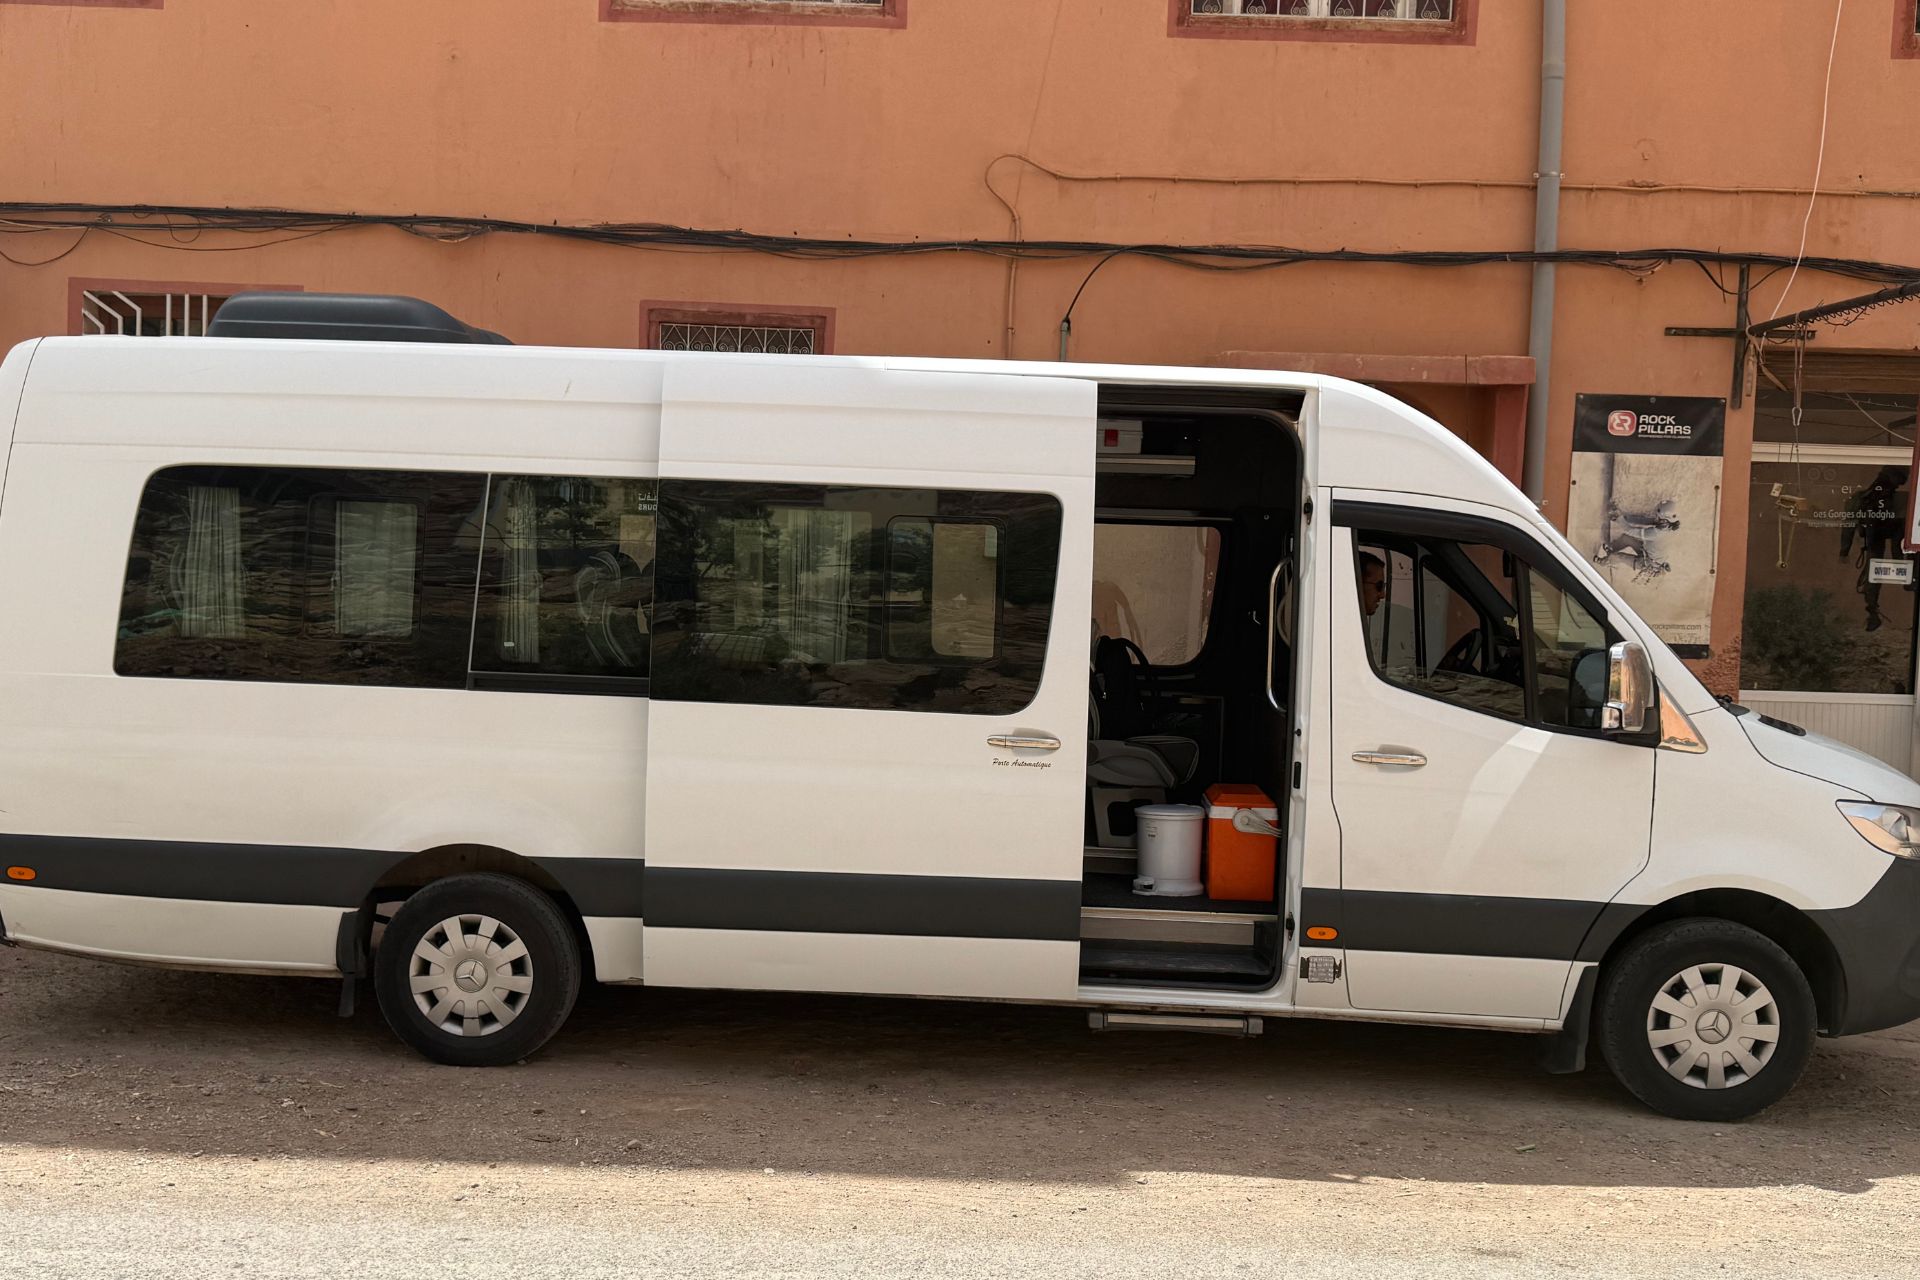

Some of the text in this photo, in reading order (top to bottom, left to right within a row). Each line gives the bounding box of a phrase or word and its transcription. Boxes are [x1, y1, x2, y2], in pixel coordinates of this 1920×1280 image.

[1639, 414, 1676, 424] ROCK
[1638, 425, 1692, 435] PILLARS
[1828, 509, 1855, 520] Gorges
[1856, 509, 1866, 518] du
[992, 757, 1052, 770] Porte Automatique
